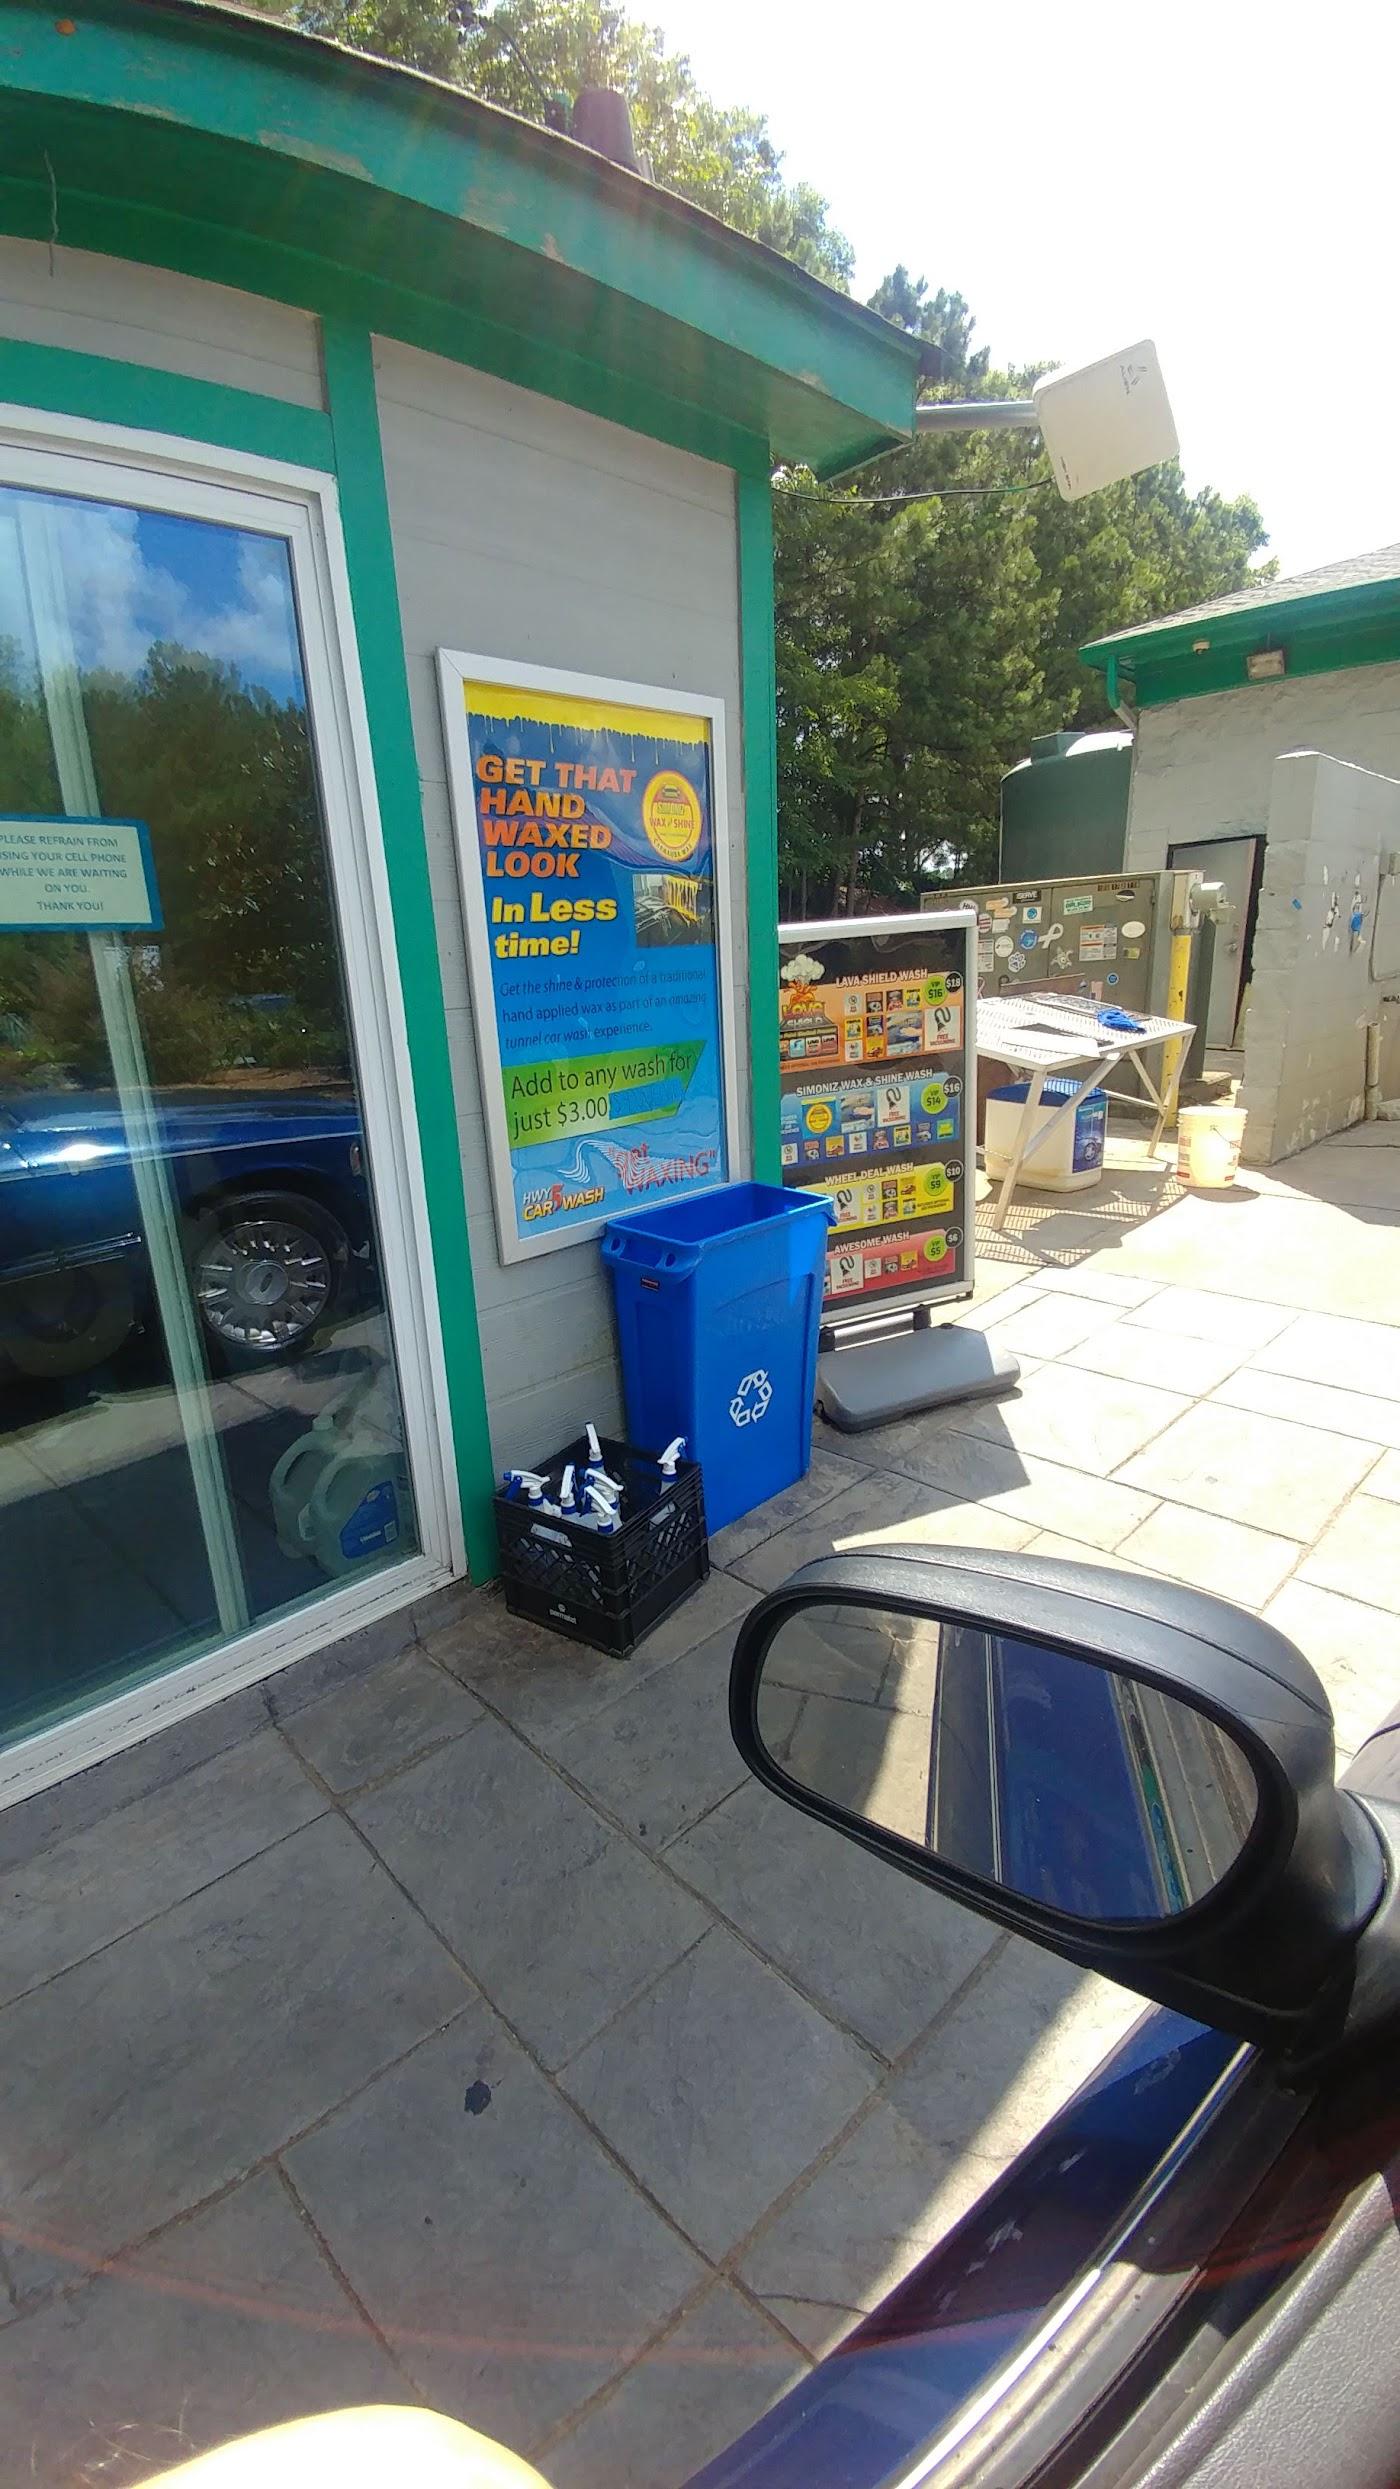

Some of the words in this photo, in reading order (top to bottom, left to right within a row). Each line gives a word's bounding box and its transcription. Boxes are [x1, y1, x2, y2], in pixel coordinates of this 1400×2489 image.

[476, 755, 547, 787] GET
[554, 763, 637, 793] THAT
[480, 788, 586, 820] HAND
[39, 836, 85, 846] REFRAIN
[87, 838, 118, 847] FROM
[482, 820, 612, 850] WAXED
[31, 852, 63, 861] YOUR
[65, 852, 88, 861] CELL
[91, 853, 127, 863] PHONE
[486, 851, 581, 878] LOOK
[0, 868, 33, 877] WHILE
[37, 868, 55, 877] WE
[57, 868, 79, 877] ARE
[80, 869, 128, 878] WAITING
[44, 884, 62, 893] ON
[36, 901, 75, 910] THANK
[76, 901, 104, 911] YOU!
[491, 896, 525, 924] In
[529, 892, 618, 923] Less
[494, 930, 581, 958] time!
[500, 982, 520, 996] Get
[524, 981, 540, 994] the
[543, 978, 573, 992] shine
[574, 976, 583, 991] &
[585, 974, 637, 992] protection
[640, 970, 649, 984] of
[835, 976, 862, 988] LAVA
[863, 973, 899, 985] SHIELD
[899, 969, 929, 981] WASH
[945, 977, 961, 988] $18
[928, 987, 943, 999] $16
[502, 1007, 534, 1023] hand
[536, 1002, 579, 1021] applied
[581, 1003, 602, 1015] wax
[605, 999, 616, 1012] as
[619, 997, 640, 1013] part
[643, 995, 652, 1008] of
[655, 997, 666, 1007] an
[505, 1031, 542, 1049] tunnel
[544, 1033, 561, 1044] car
[564, 1028, 590, 1042] wash
[594, 1022, 653, 1040] experience.
[511, 1073, 552, 1099] Add
[558, 1070, 579, 1091] to
[584, 1065, 617, 1089] any
[622, 1055, 665, 1080] wash
[670, 1051, 692, 1072] for
[796, 1082, 840, 1097] SIMONIZ
[841, 1078, 864, 1091] WAX
[865, 1076, 873, 1086] &
[875, 1073, 905, 1085] SHINE
[906, 1069, 933, 1081] WASH
[944, 1082, 960, 1093] $16
[926, 1095, 941, 1106] $14
[513, 1110, 553, 1140] just
[557, 1096, 608, 1127] $3.00
[825, 1173, 859, 1187] WHEEL
[860, 1168, 885, 1181] DEAL
[885, 1163, 914, 1176] WASH
[947, 1166, 961, 1177] $10
[522, 1187, 552, 1205] HWY
[523, 1202, 554, 1221] CAR
[563, 1187, 605, 1211] WASH
[834, 1238, 882, 1255] AWESOME
[882, 1232, 911, 1245] WASH
